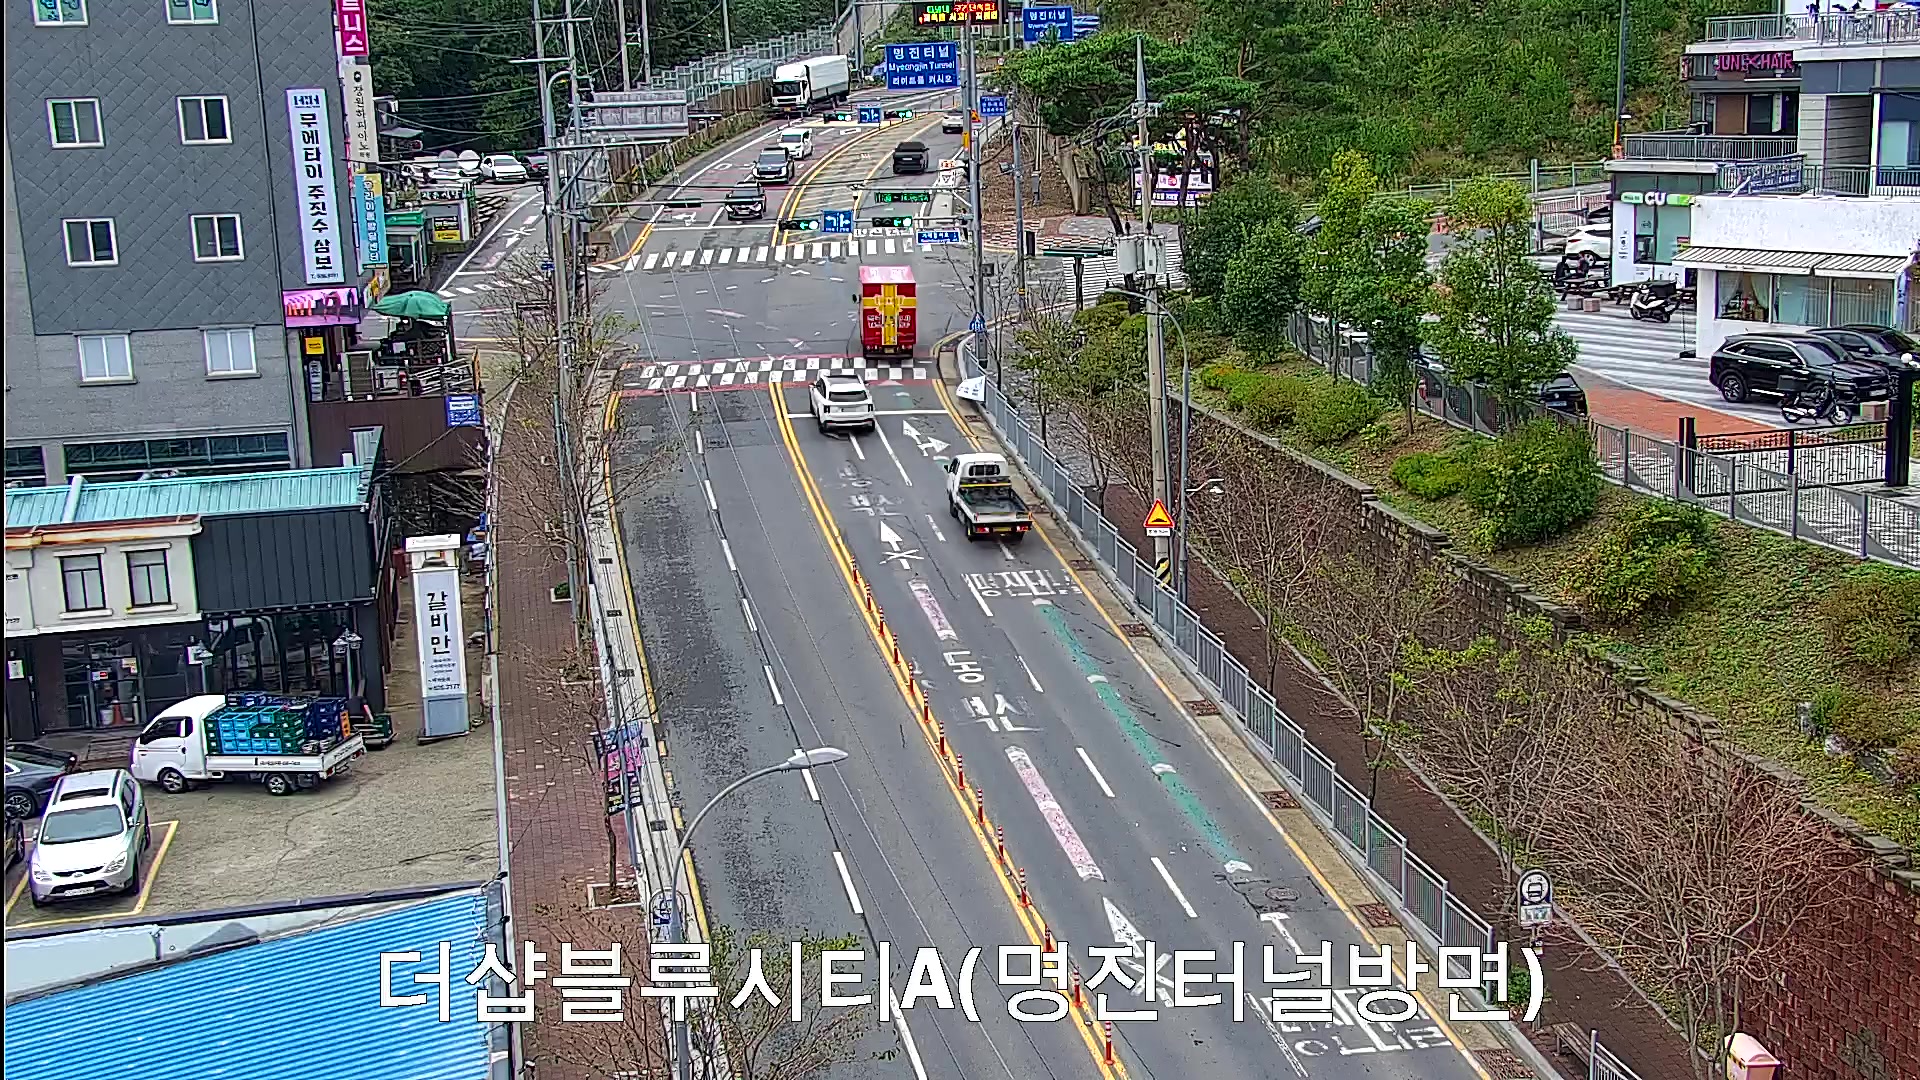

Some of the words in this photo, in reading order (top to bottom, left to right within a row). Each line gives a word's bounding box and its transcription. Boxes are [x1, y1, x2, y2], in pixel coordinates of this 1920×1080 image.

[1029, 10, 1066, 21] 명진터널
[893, 45, 949, 60] 명진터널
[929, 60, 955, 70] Tunnel
[1761, 52, 1794, 70] HAIR
[299, 112, 324, 179] 무에타이
[1644, 191, 1666, 206] CU
[307, 184, 329, 233] 주짓수
[314, 239, 333, 270] 삼보
